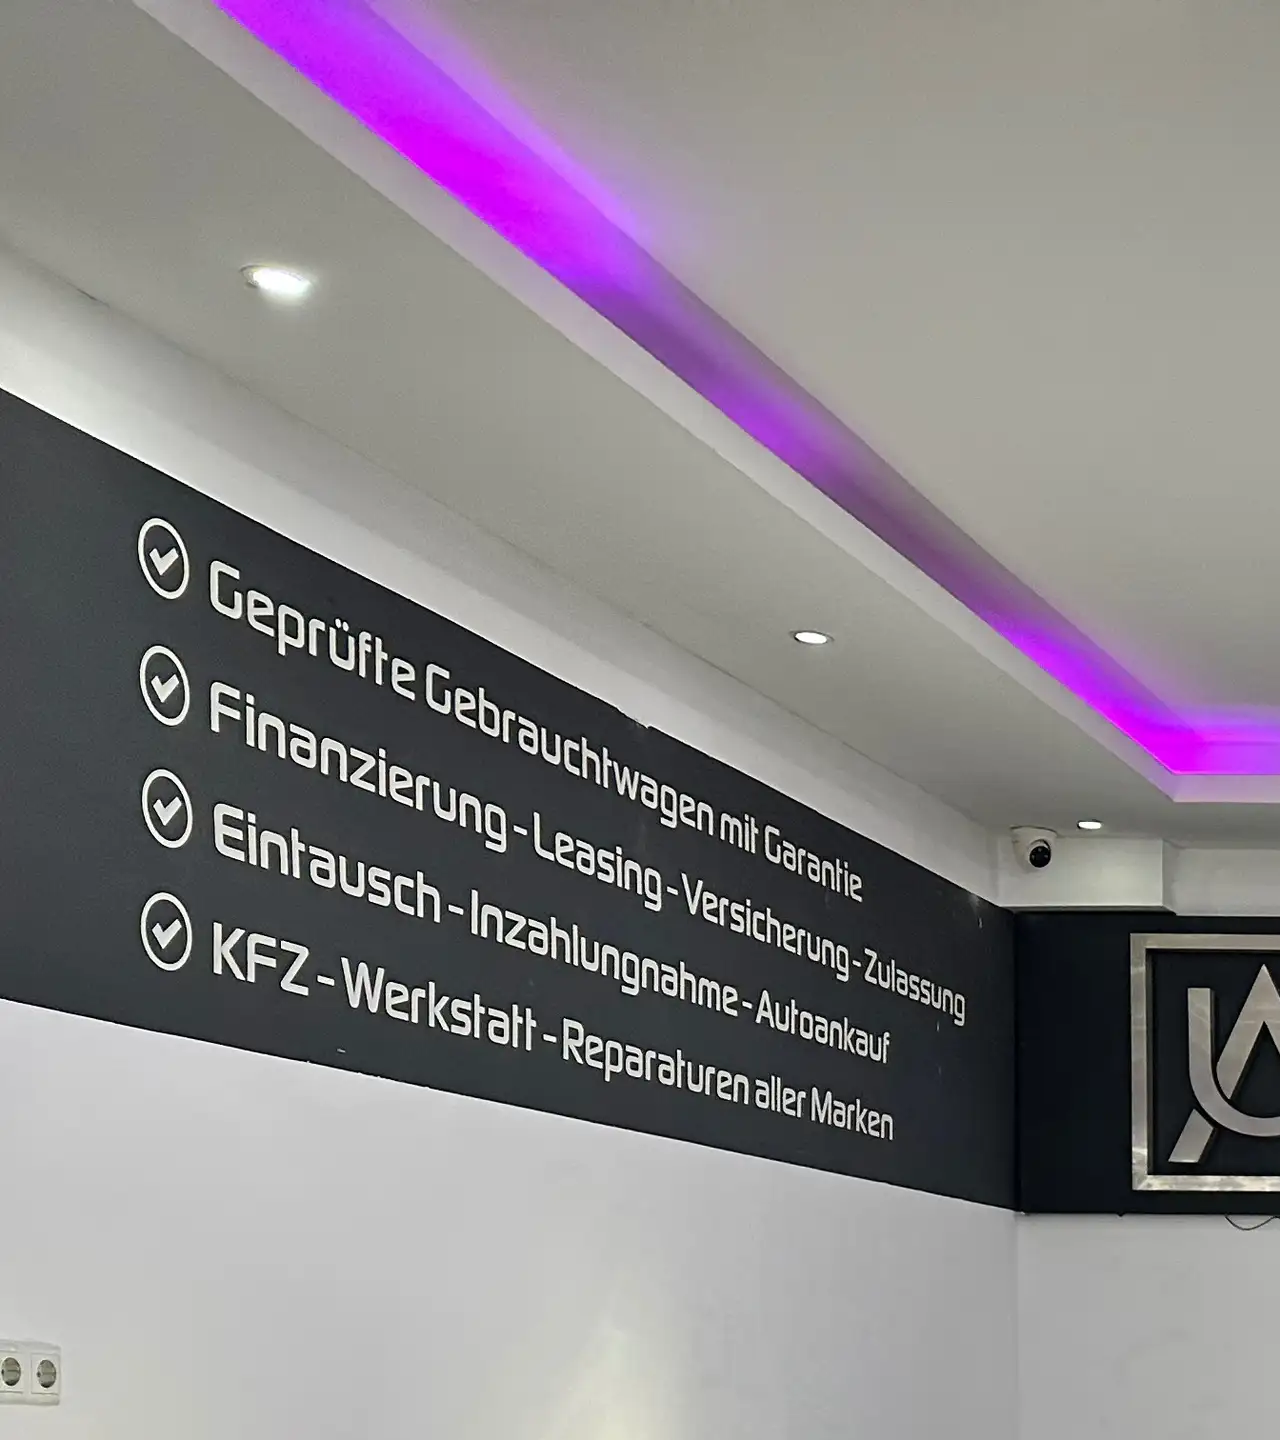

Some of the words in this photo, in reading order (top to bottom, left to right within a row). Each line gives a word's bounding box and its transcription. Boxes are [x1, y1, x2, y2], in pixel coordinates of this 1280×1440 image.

[209, 560, 416, 701] Geprüfte
[425, 663, 714, 836] Gebrauchtwagen
[719, 812, 759, 854] mit
[764, 824, 863, 903] Garantie
[210, 681, 507, 854] Finanzierung
[533, 811, 662, 912] Leasing
[681, 872, 850, 983] Versicherung
[864, 947, 966, 1027] Zulassung
[213, 803, 441, 924] Eintausch
[470, 889, 739, 1017] Inzahlungnahme
[755, 989, 890, 1064] Autoankauf
[213, 921, 310, 997] KFZ
[340, 956, 537, 1052] Werkstatt
[562, 1017, 750, 1105] Reparaturen
[755, 1075, 807, 1118] aller
[811, 1086, 894, 1141] Marken
